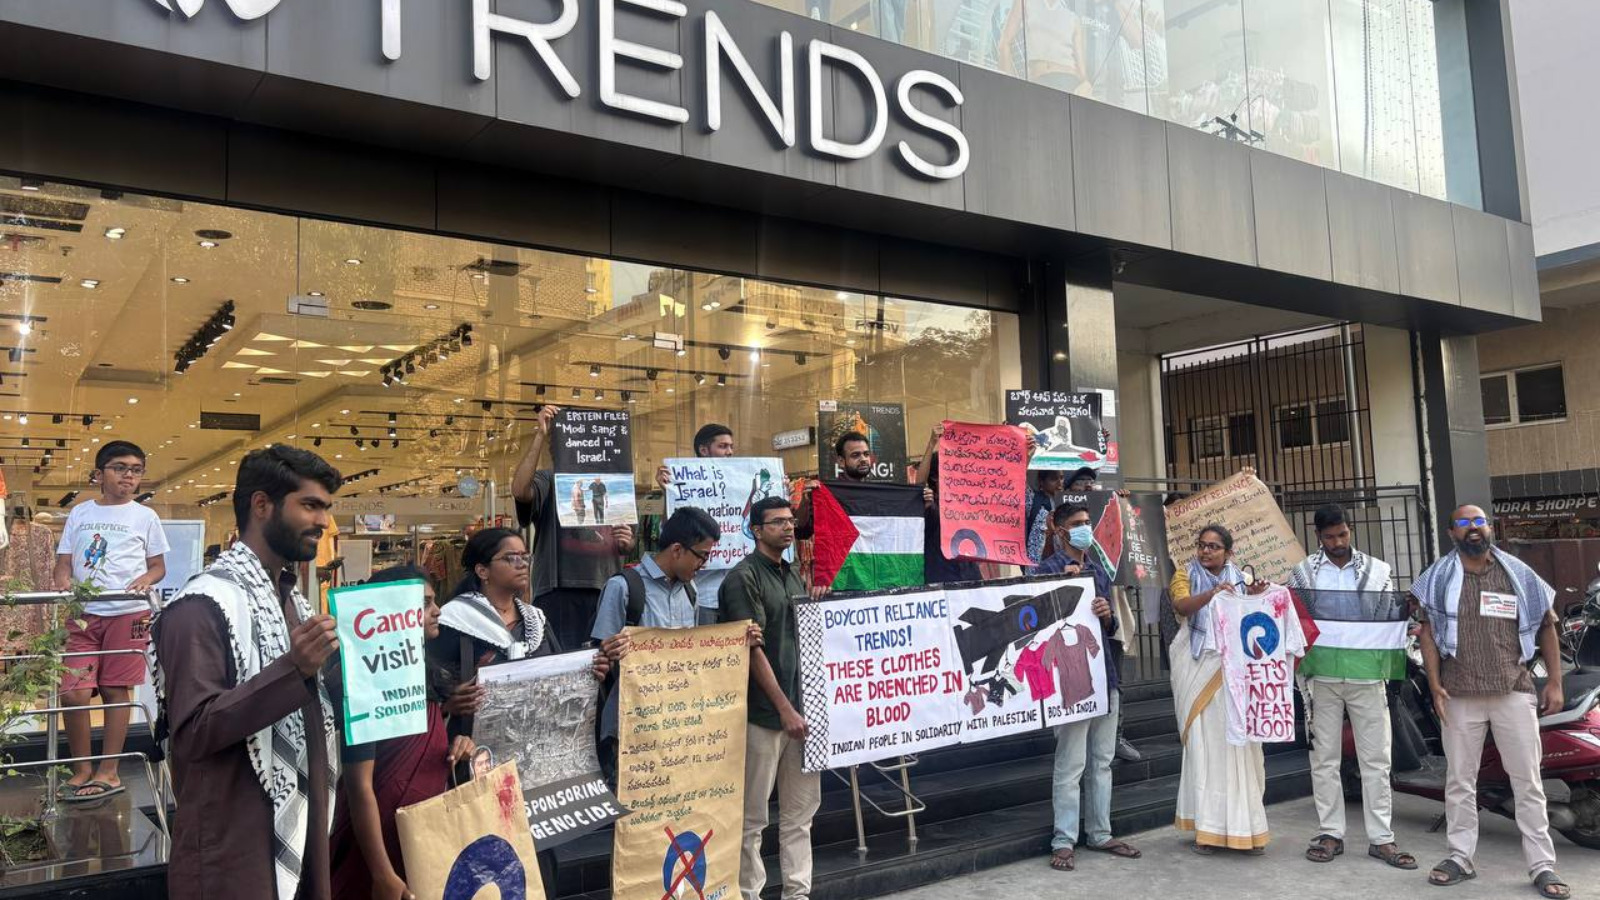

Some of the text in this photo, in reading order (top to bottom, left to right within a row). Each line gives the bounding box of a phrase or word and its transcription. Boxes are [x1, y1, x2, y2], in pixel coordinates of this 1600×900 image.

[566, 411, 602, 421] EPSTEIN
[871, 405, 900, 415] TRENDS
[565, 437, 614, 448] danced in
[672, 464, 724, 481] What is
[674, 481, 726, 501] Israel?
[1063, 494, 1088, 504] FROM
[1174, 494, 1208, 517] BOYCOTT
[1211, 476, 1253, 499] RELIANCE
[1128, 552, 1158, 566] FREE!
[824, 599, 947, 629] BOYCOTT RELIANCE
[855, 625, 912, 652] TRENDS!
[362, 638, 419, 674] visit
[826, 647, 941, 681] THESE CLOTHES
[834, 670, 963, 705] ARE DRENCHED IN
[1249, 683, 1289, 702] NOT
[866, 702, 911, 728] BLOOD
[1048, 701, 1098, 719] BDS IN INDIA
[831, 709, 1037, 755] INDIAN PEOPLE IN SOLIDARITY WITH PALESTINE
[524, 779, 609, 818] SPONSORING
[529, 801, 620, 840] GENOCIDE
